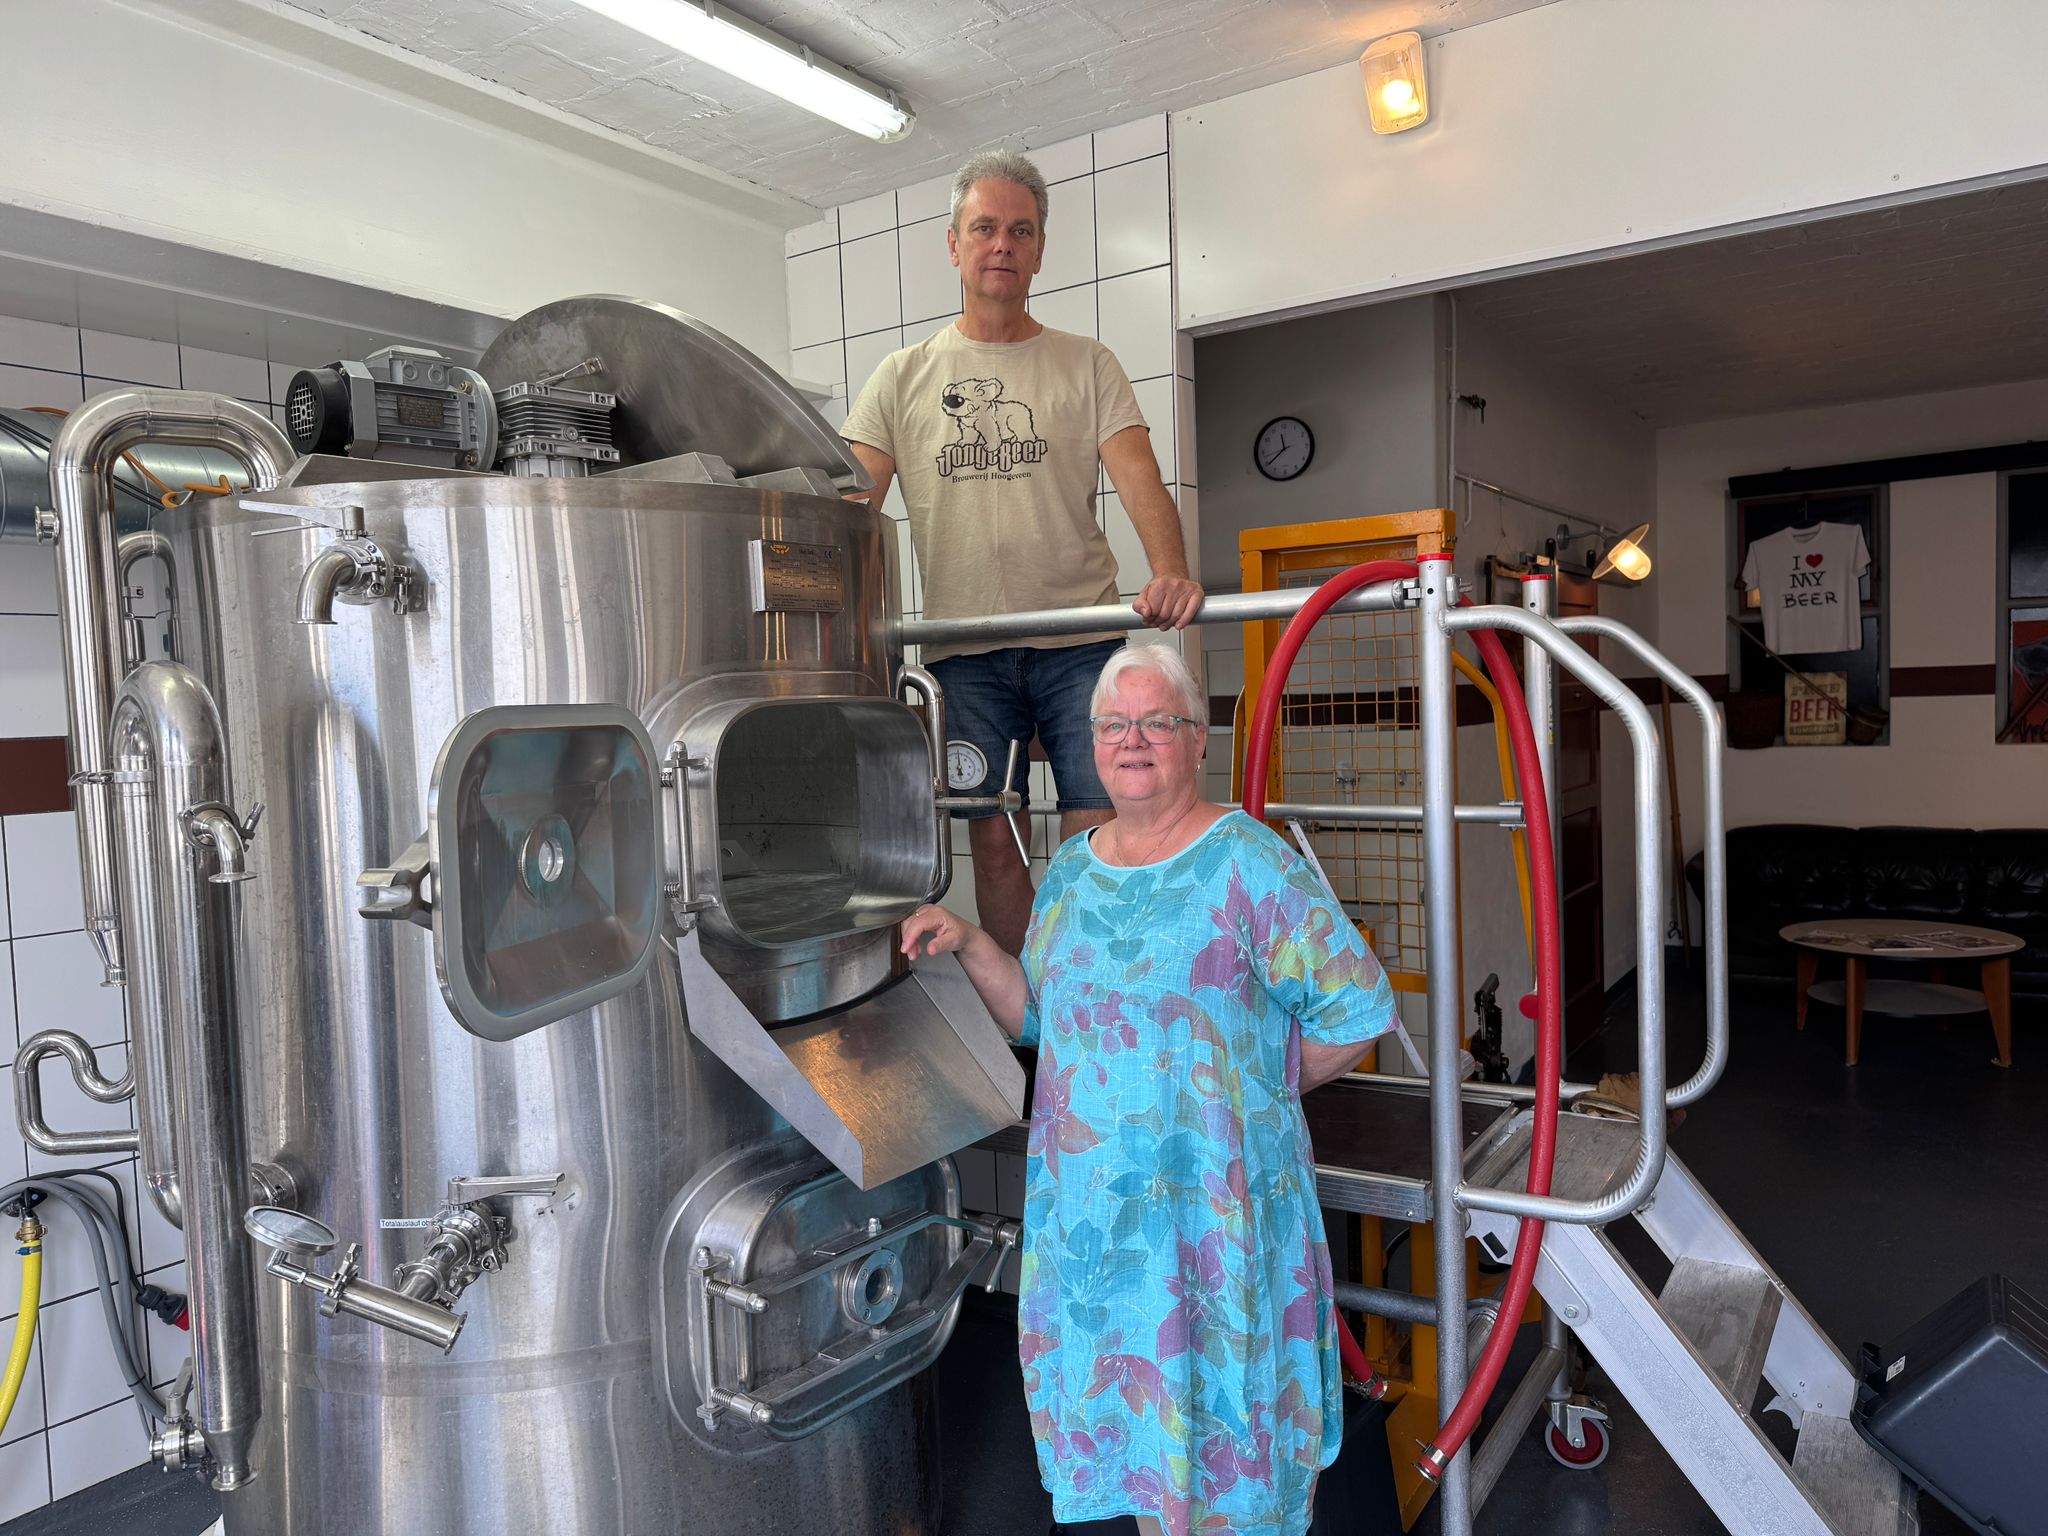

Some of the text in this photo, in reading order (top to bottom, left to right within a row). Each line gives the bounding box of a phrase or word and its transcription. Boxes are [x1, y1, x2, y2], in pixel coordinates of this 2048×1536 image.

[952, 471, 1032, 484] Brouwerij Hoogeveen
[1792, 555, 1802, 571] I
[1782, 591, 1838, 609] BEER
[1789, 697, 1839, 723] BEER
